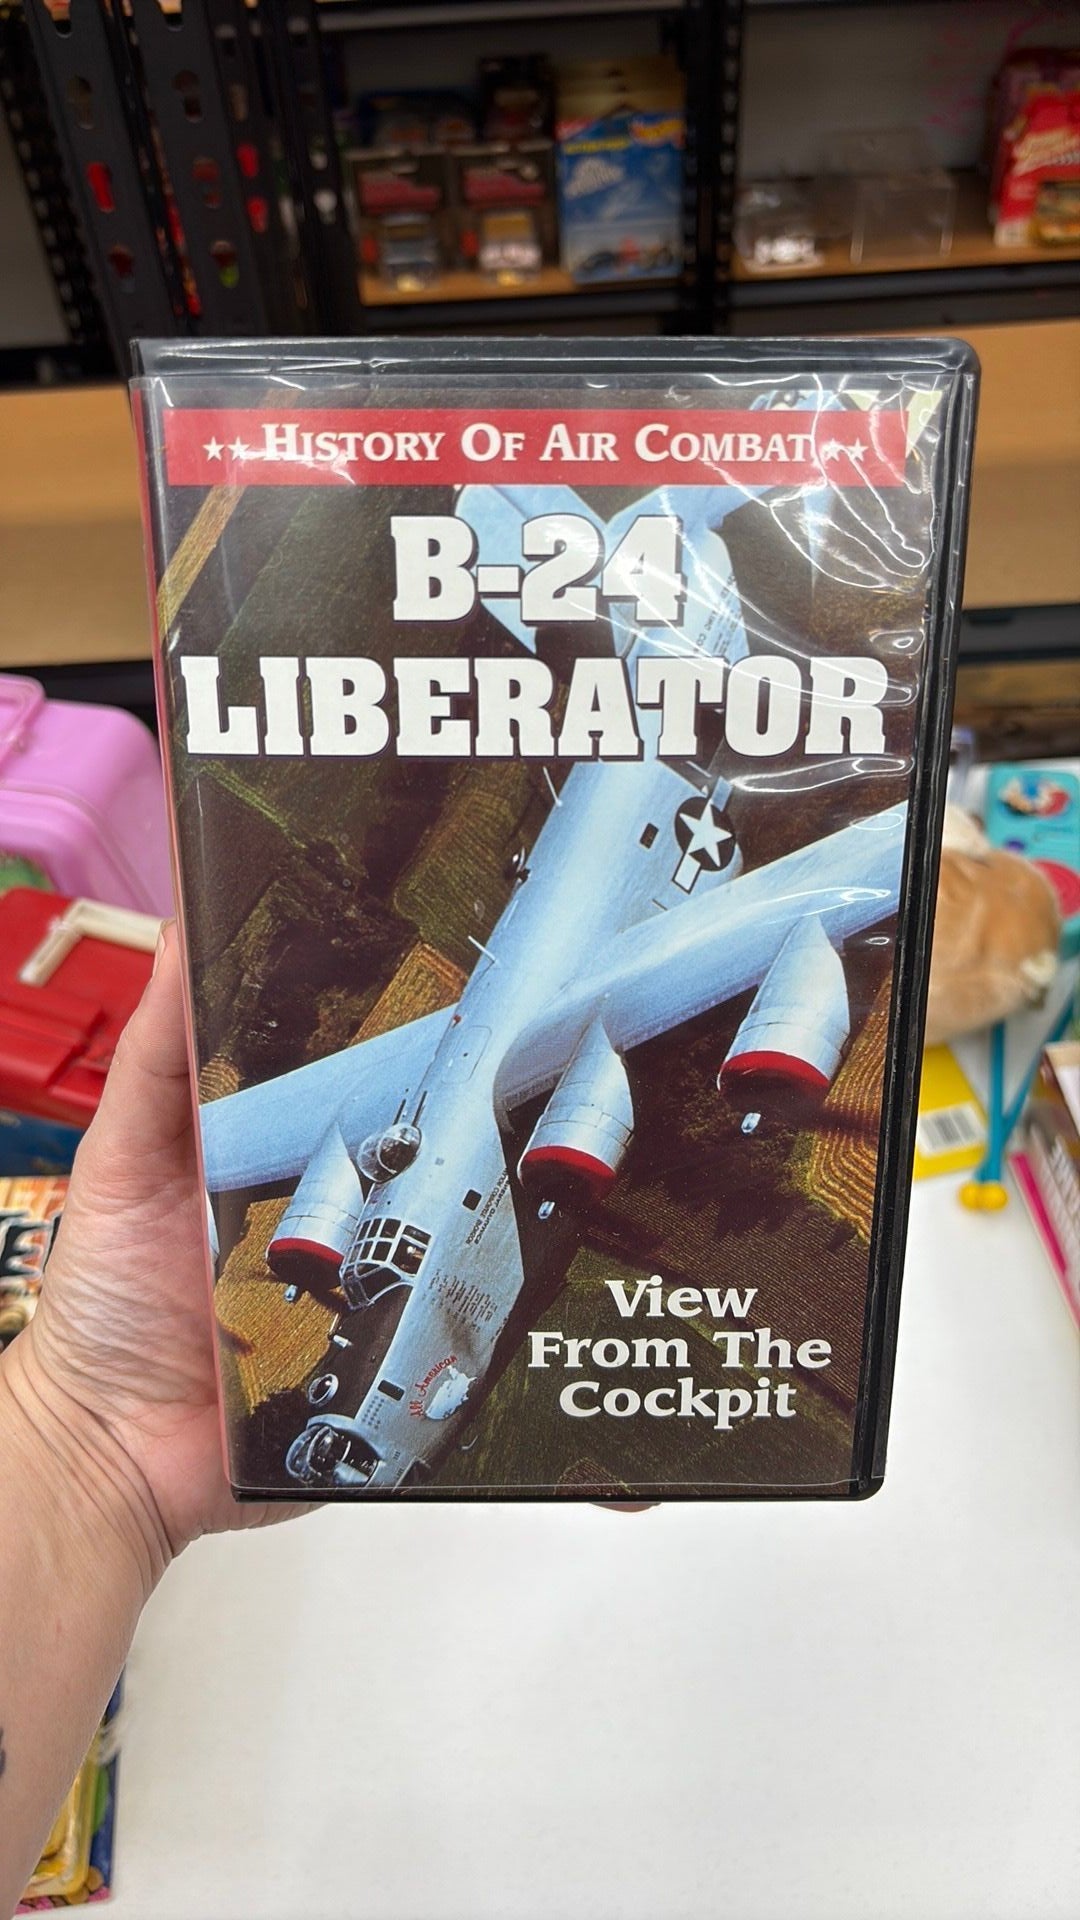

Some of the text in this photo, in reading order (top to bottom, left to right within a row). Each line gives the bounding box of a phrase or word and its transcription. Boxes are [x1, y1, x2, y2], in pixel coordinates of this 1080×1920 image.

[262, 423, 814, 462] HISTORY OF AIR COMBAT
[391, 515, 685, 623] B-24
[181, 656, 889, 757] LIBERATOR
[604, 1275, 758, 1318] View
[528, 1327, 832, 1369] From The
[559, 1376, 797, 1430] Cockpit
